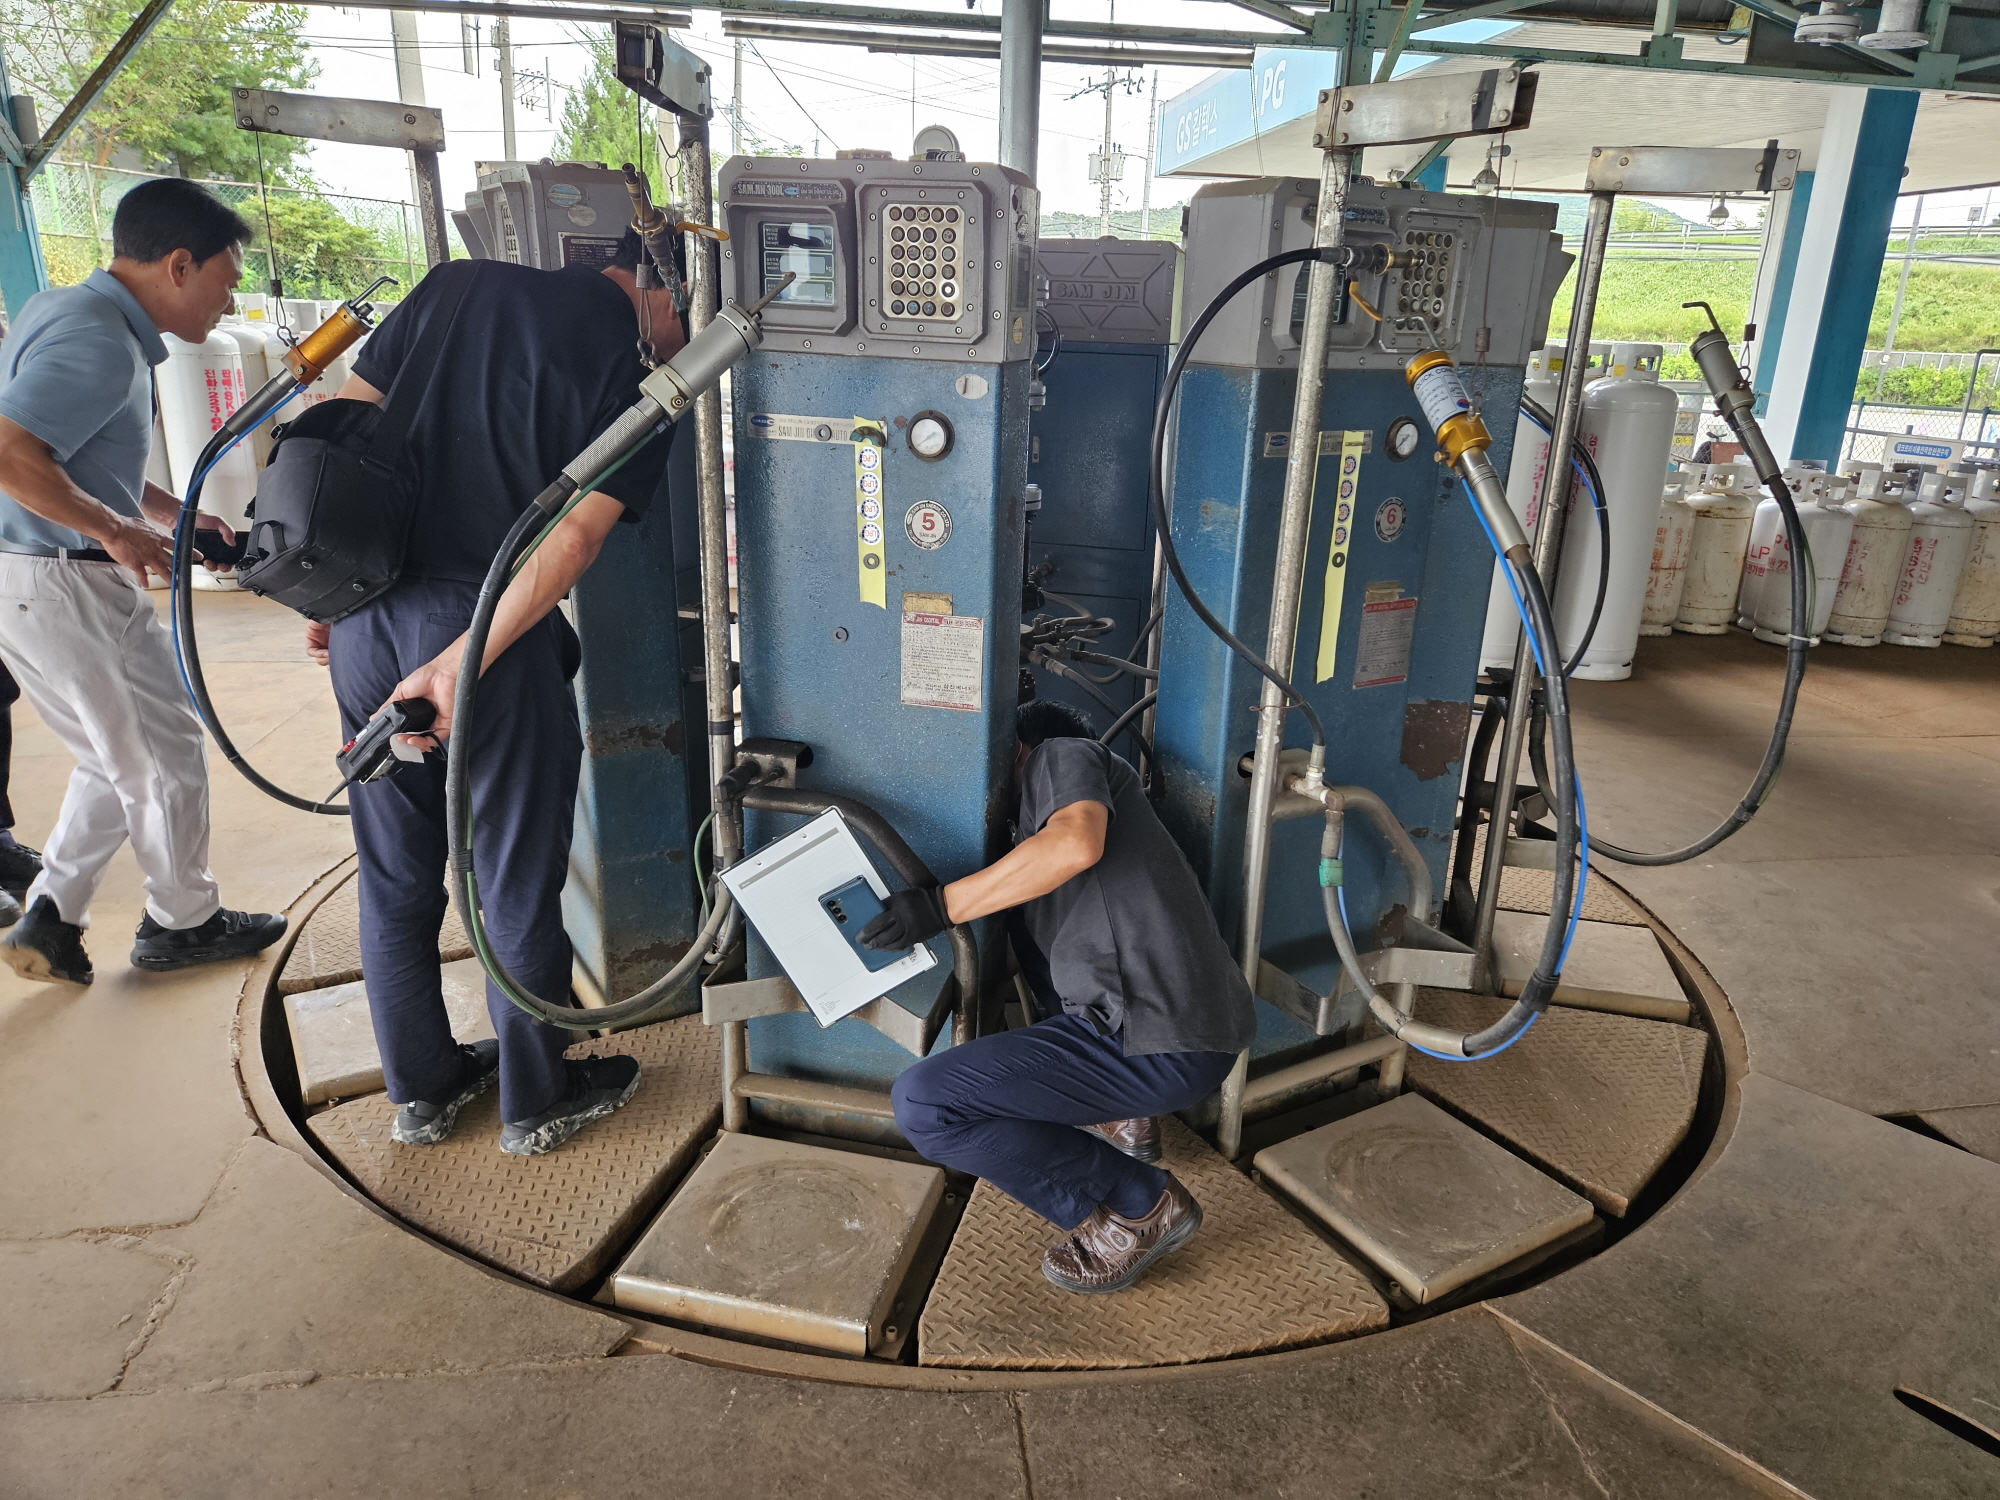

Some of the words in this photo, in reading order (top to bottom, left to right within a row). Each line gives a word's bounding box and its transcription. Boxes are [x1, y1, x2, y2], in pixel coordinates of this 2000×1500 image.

[1251, 59, 1287, 120] LPG
[1176, 98, 1218, 154] GS칼텍스
[1056, 283, 1093, 299] SAM
[1102, 284, 1135, 300] JIN
[778, 425, 793, 438] SAM
[794, 426, 805, 439] JIN
[832, 428, 848, 441] AUTO
[862, 454, 875, 463] LPG
[863, 480, 875, 488] LPG
[864, 505, 876, 513] LPG
[1386, 507, 1397, 525] 6
[922, 512, 935, 531] 5
[865, 530, 877, 538] LPG
